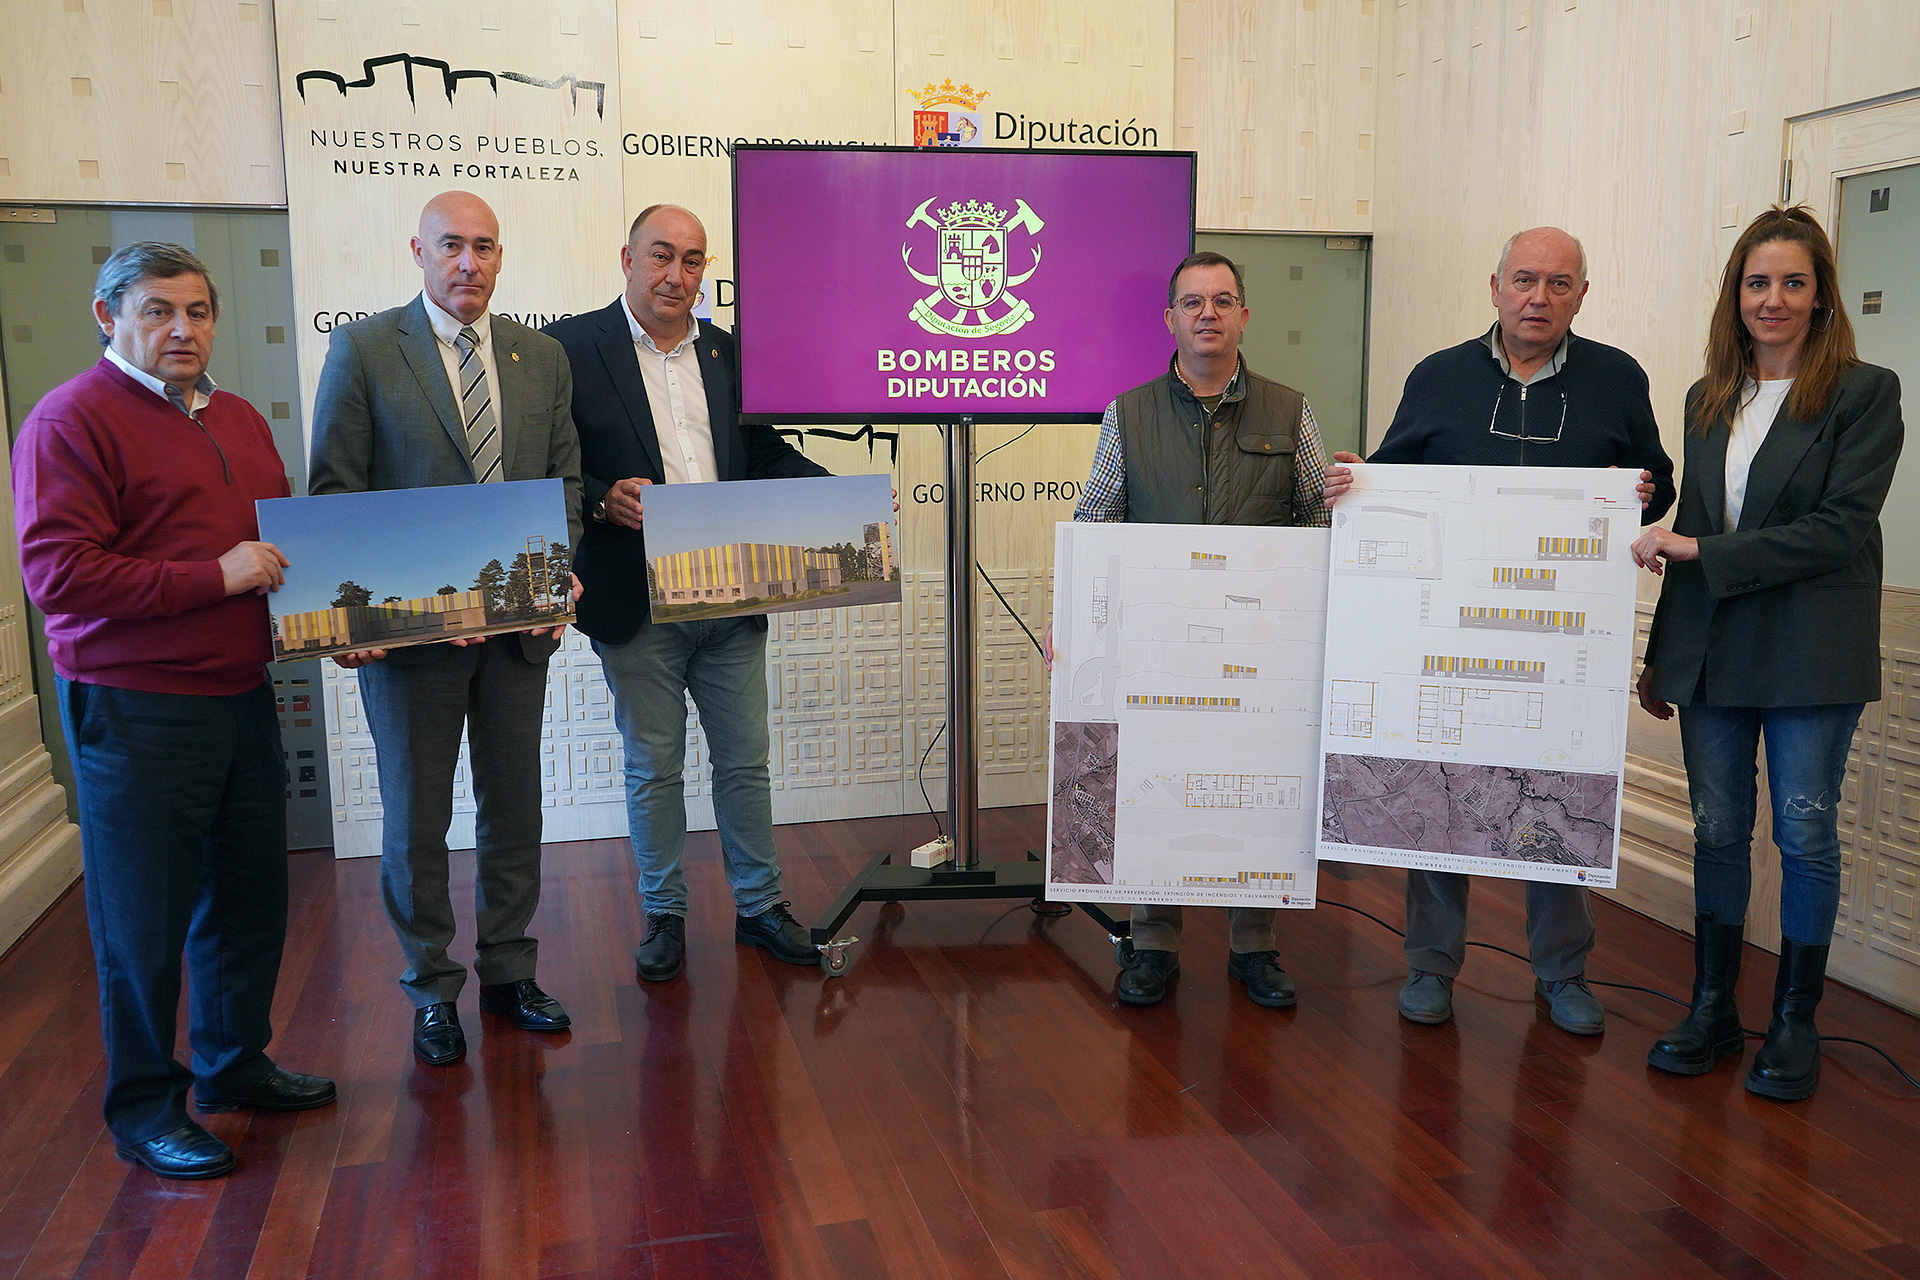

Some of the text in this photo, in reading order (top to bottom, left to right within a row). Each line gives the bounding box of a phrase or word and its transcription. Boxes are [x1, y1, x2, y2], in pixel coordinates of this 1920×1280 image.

[310, 129, 462, 151] NUESTROS
[995, 111, 1158, 148] Diputación
[334, 160, 580, 182] NUESTRA FORTALEZA
[925, 310, 969, 334] Diputación
[984, 314, 1016, 331] Segovia
[877, 349, 1056, 372] BOMBEROS
[887, 372, 1047, 398] DIPUTACIÓN
[1351, 848, 1387, 856] PROVINCIAL
[1444, 857, 1478, 865] EXTINCIÓN
[1491, 862, 1526, 870] INCENDIOS
[1535, 866, 1578, 875] SALVAMENTO
[1415, 862, 1452, 870] BOMBEROS
